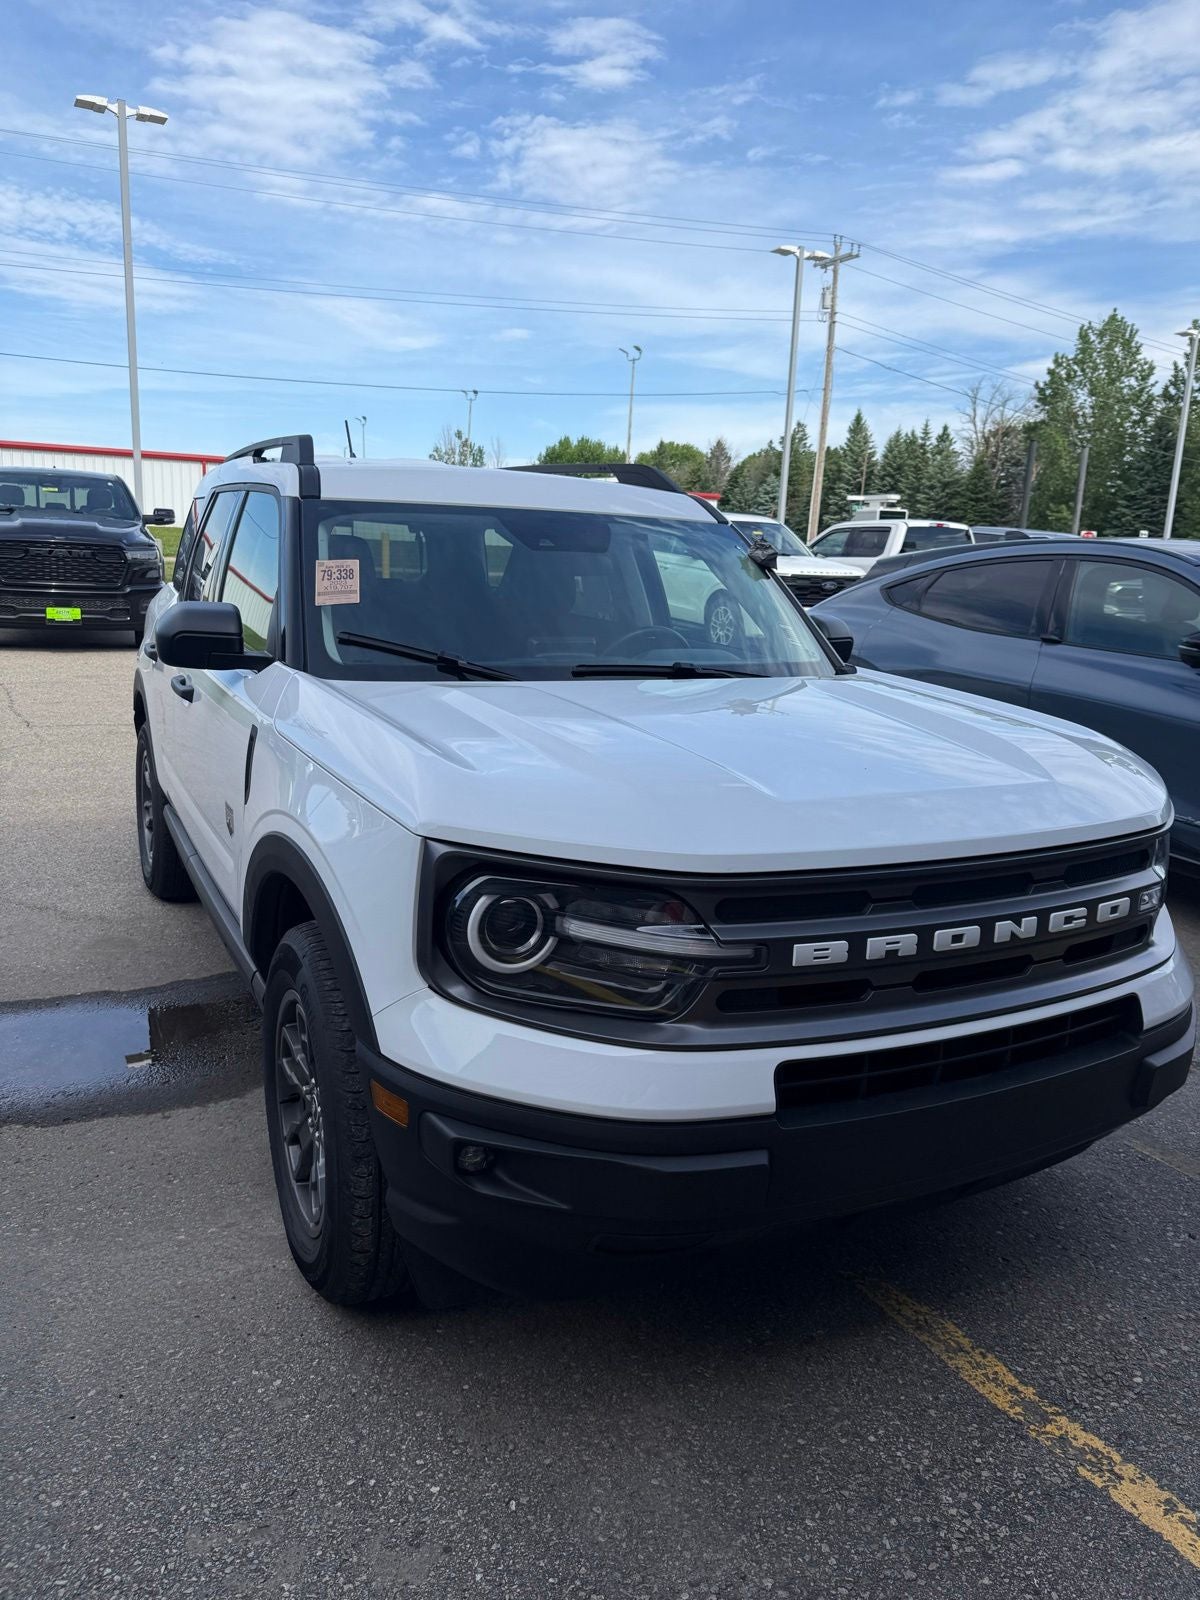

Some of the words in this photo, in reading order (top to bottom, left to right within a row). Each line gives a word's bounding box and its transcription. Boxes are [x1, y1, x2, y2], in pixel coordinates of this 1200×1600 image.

[29, 548, 92, 558] RAM
[320, 568, 354, 581] 79:338
[792, 897, 1131, 967] BRONCO
